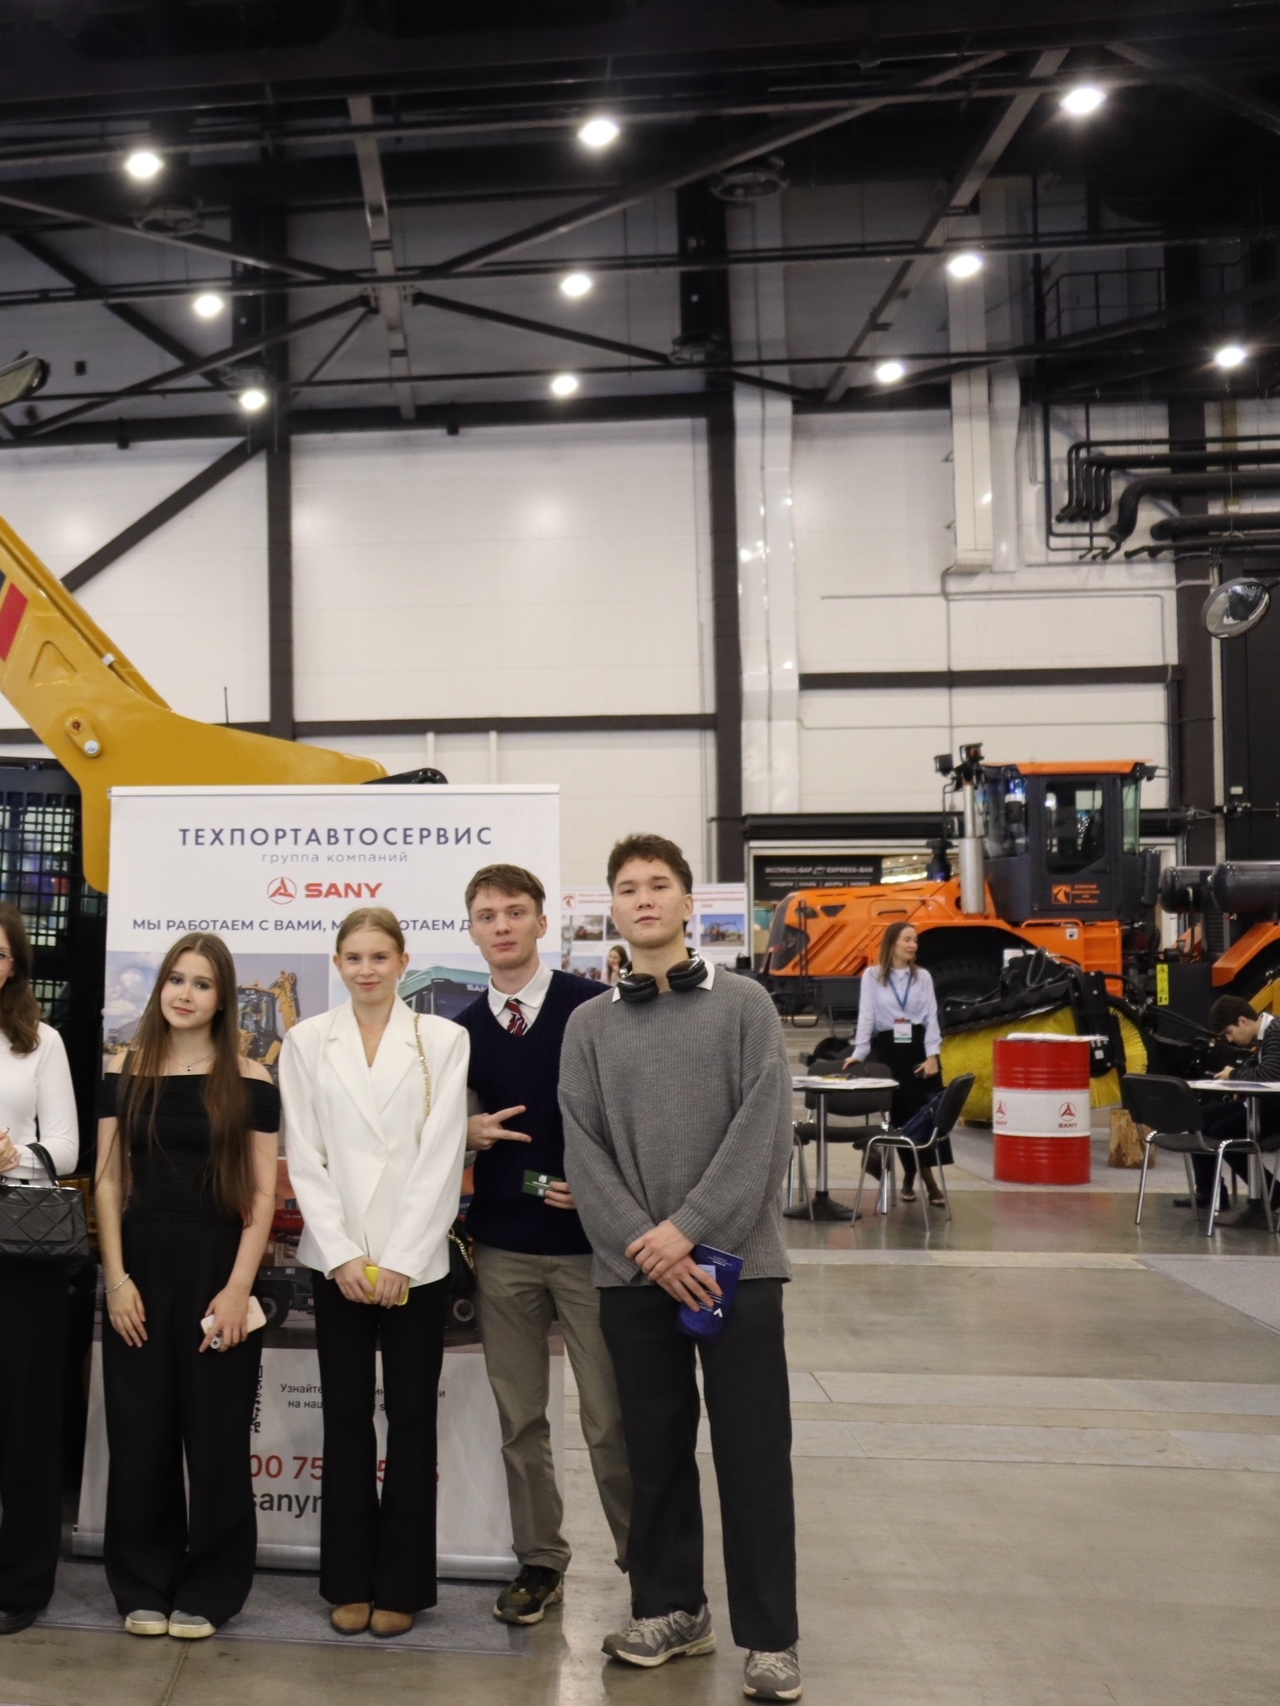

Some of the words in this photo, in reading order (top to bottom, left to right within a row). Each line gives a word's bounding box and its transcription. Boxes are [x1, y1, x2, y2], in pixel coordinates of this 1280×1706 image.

[178, 827, 492, 846] ТЕХПОРТАВТОСЕРВИС
[262, 853, 319, 864] группа
[327, 851, 408, 863] компаний
[304, 882, 383, 899] SANY
[132, 919, 161, 930] МЫ
[166, 919, 254, 931] РАБОТАЕМ
[259, 919, 269, 931] С
[274, 919, 326, 932] ВАМИ,
[400, 919, 454, 931] ОТАЕМ
[250, 1454, 283, 1479] 00
[292, 1456, 324, 1480] 75
